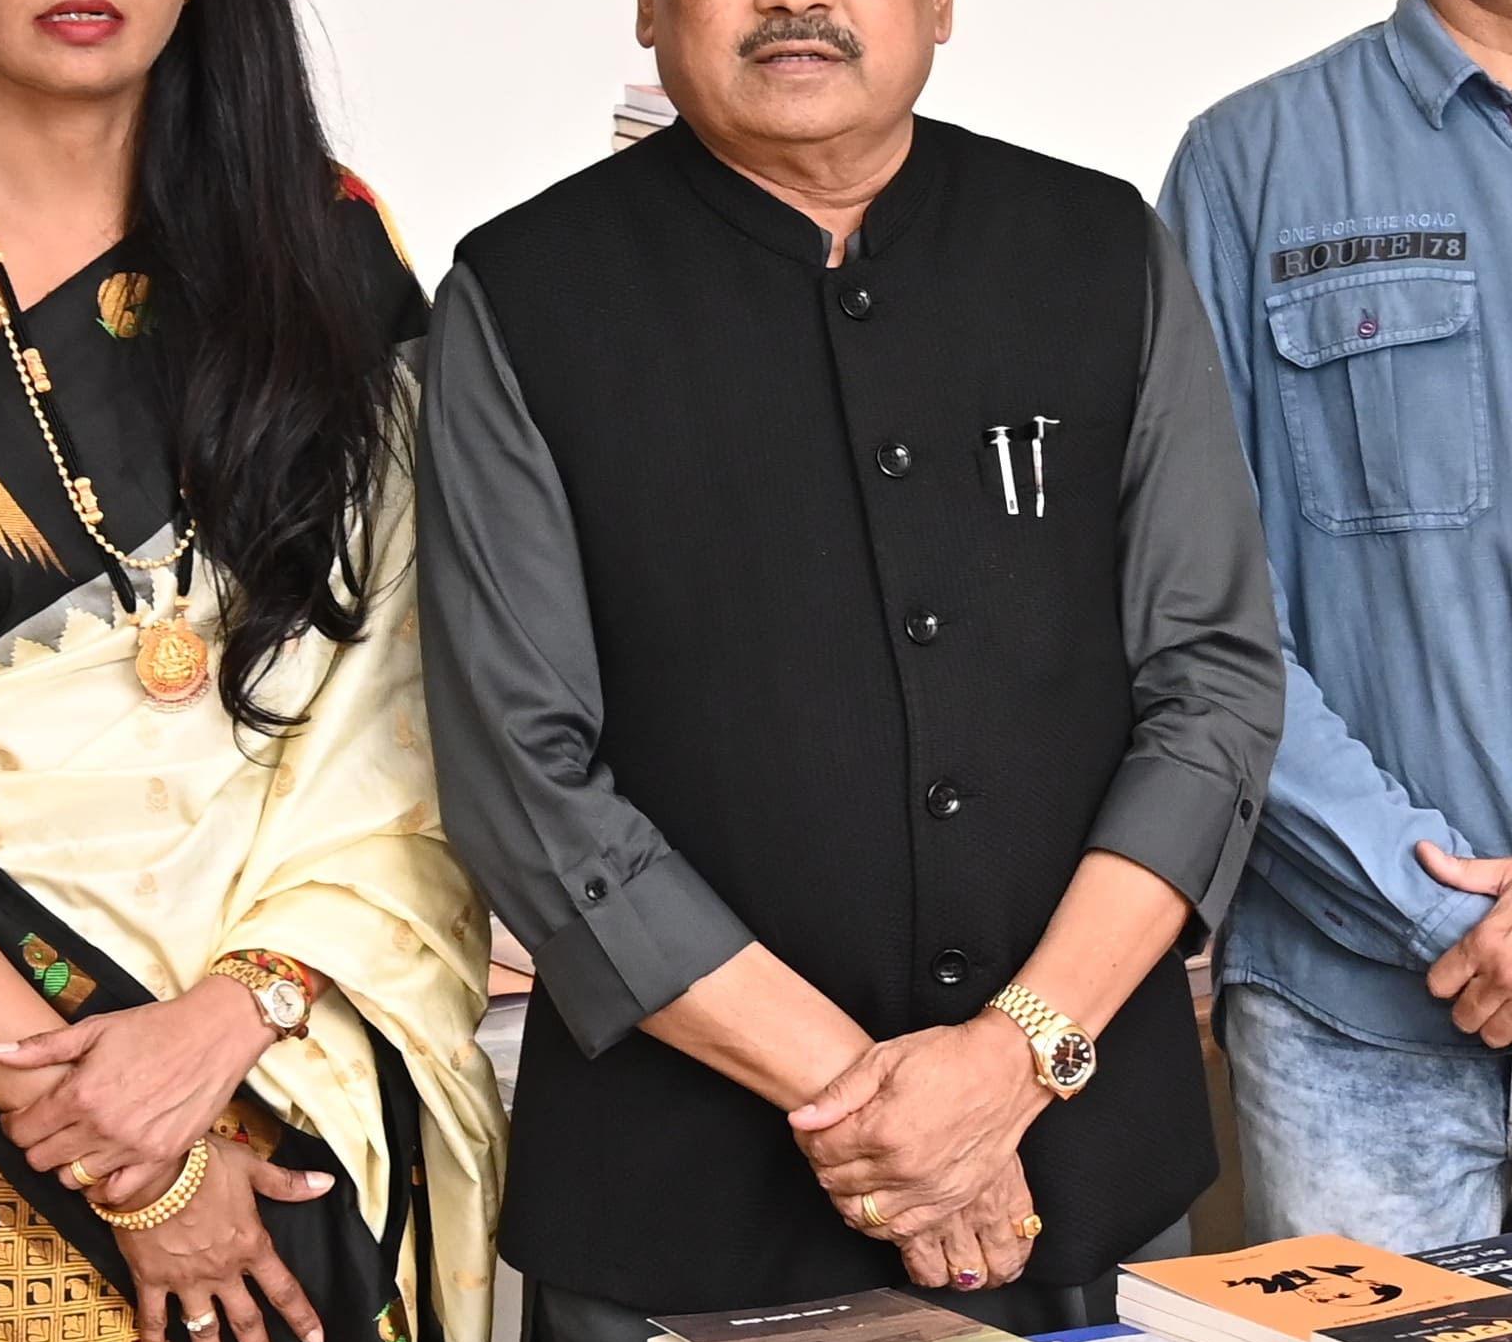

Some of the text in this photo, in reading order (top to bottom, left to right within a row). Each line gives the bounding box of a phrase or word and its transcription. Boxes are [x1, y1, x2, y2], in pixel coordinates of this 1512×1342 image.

[1278, 209, 1458, 245] ONE FOR THE ROAD
[1279, 233, 1462, 280] ROUTE 78
